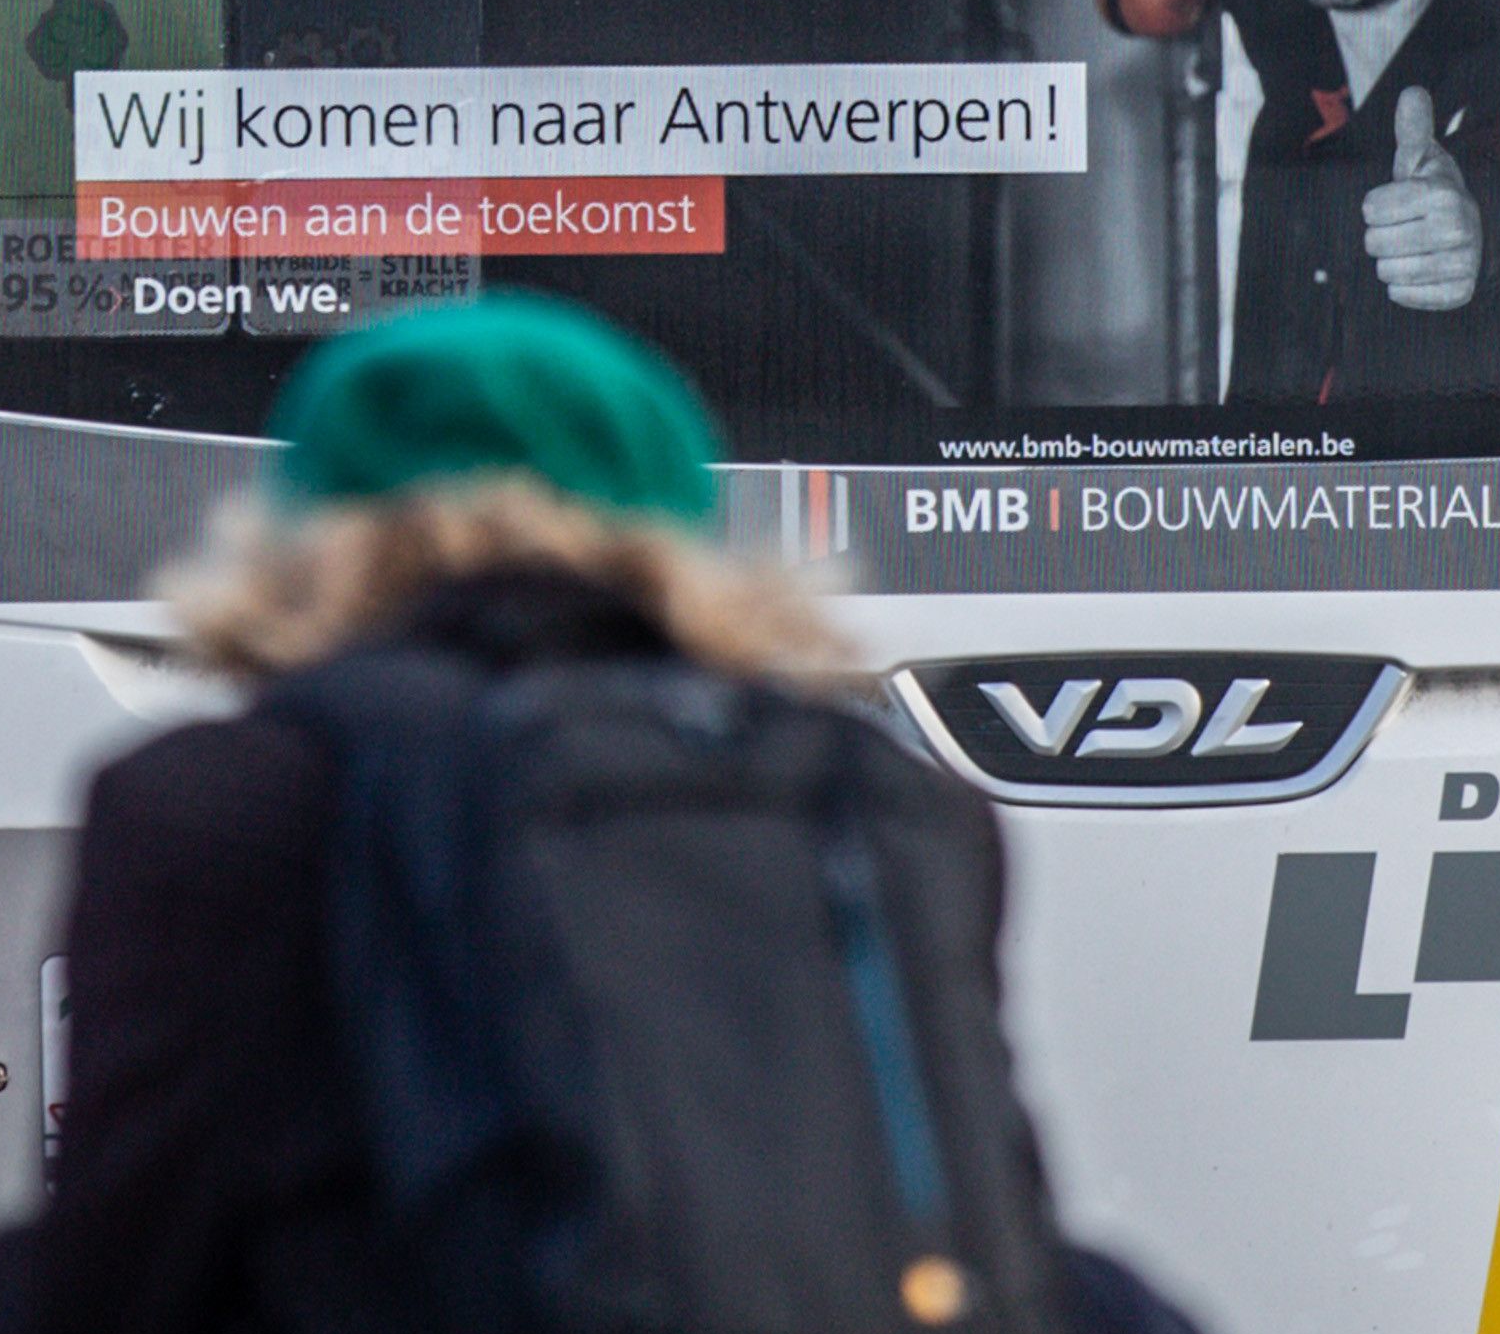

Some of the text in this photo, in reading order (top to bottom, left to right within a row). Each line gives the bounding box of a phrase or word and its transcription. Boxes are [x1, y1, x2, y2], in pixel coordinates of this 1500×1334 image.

[97, 84, 1058, 165] Wij komen naar Antwerpen!
[101, 189, 697, 239] Bouwen aan de toekomst
[380, 253, 470, 276] STILLE
[134, 276, 251, 315] Doen
[267, 283, 351, 315] we.
[380, 277, 469, 298] KRACHT
[939, 433, 1356, 459] www.bmb-bouwmaterialen.be
[905, 488, 1031, 534] BMB
[976, 677, 1305, 759] VDL
